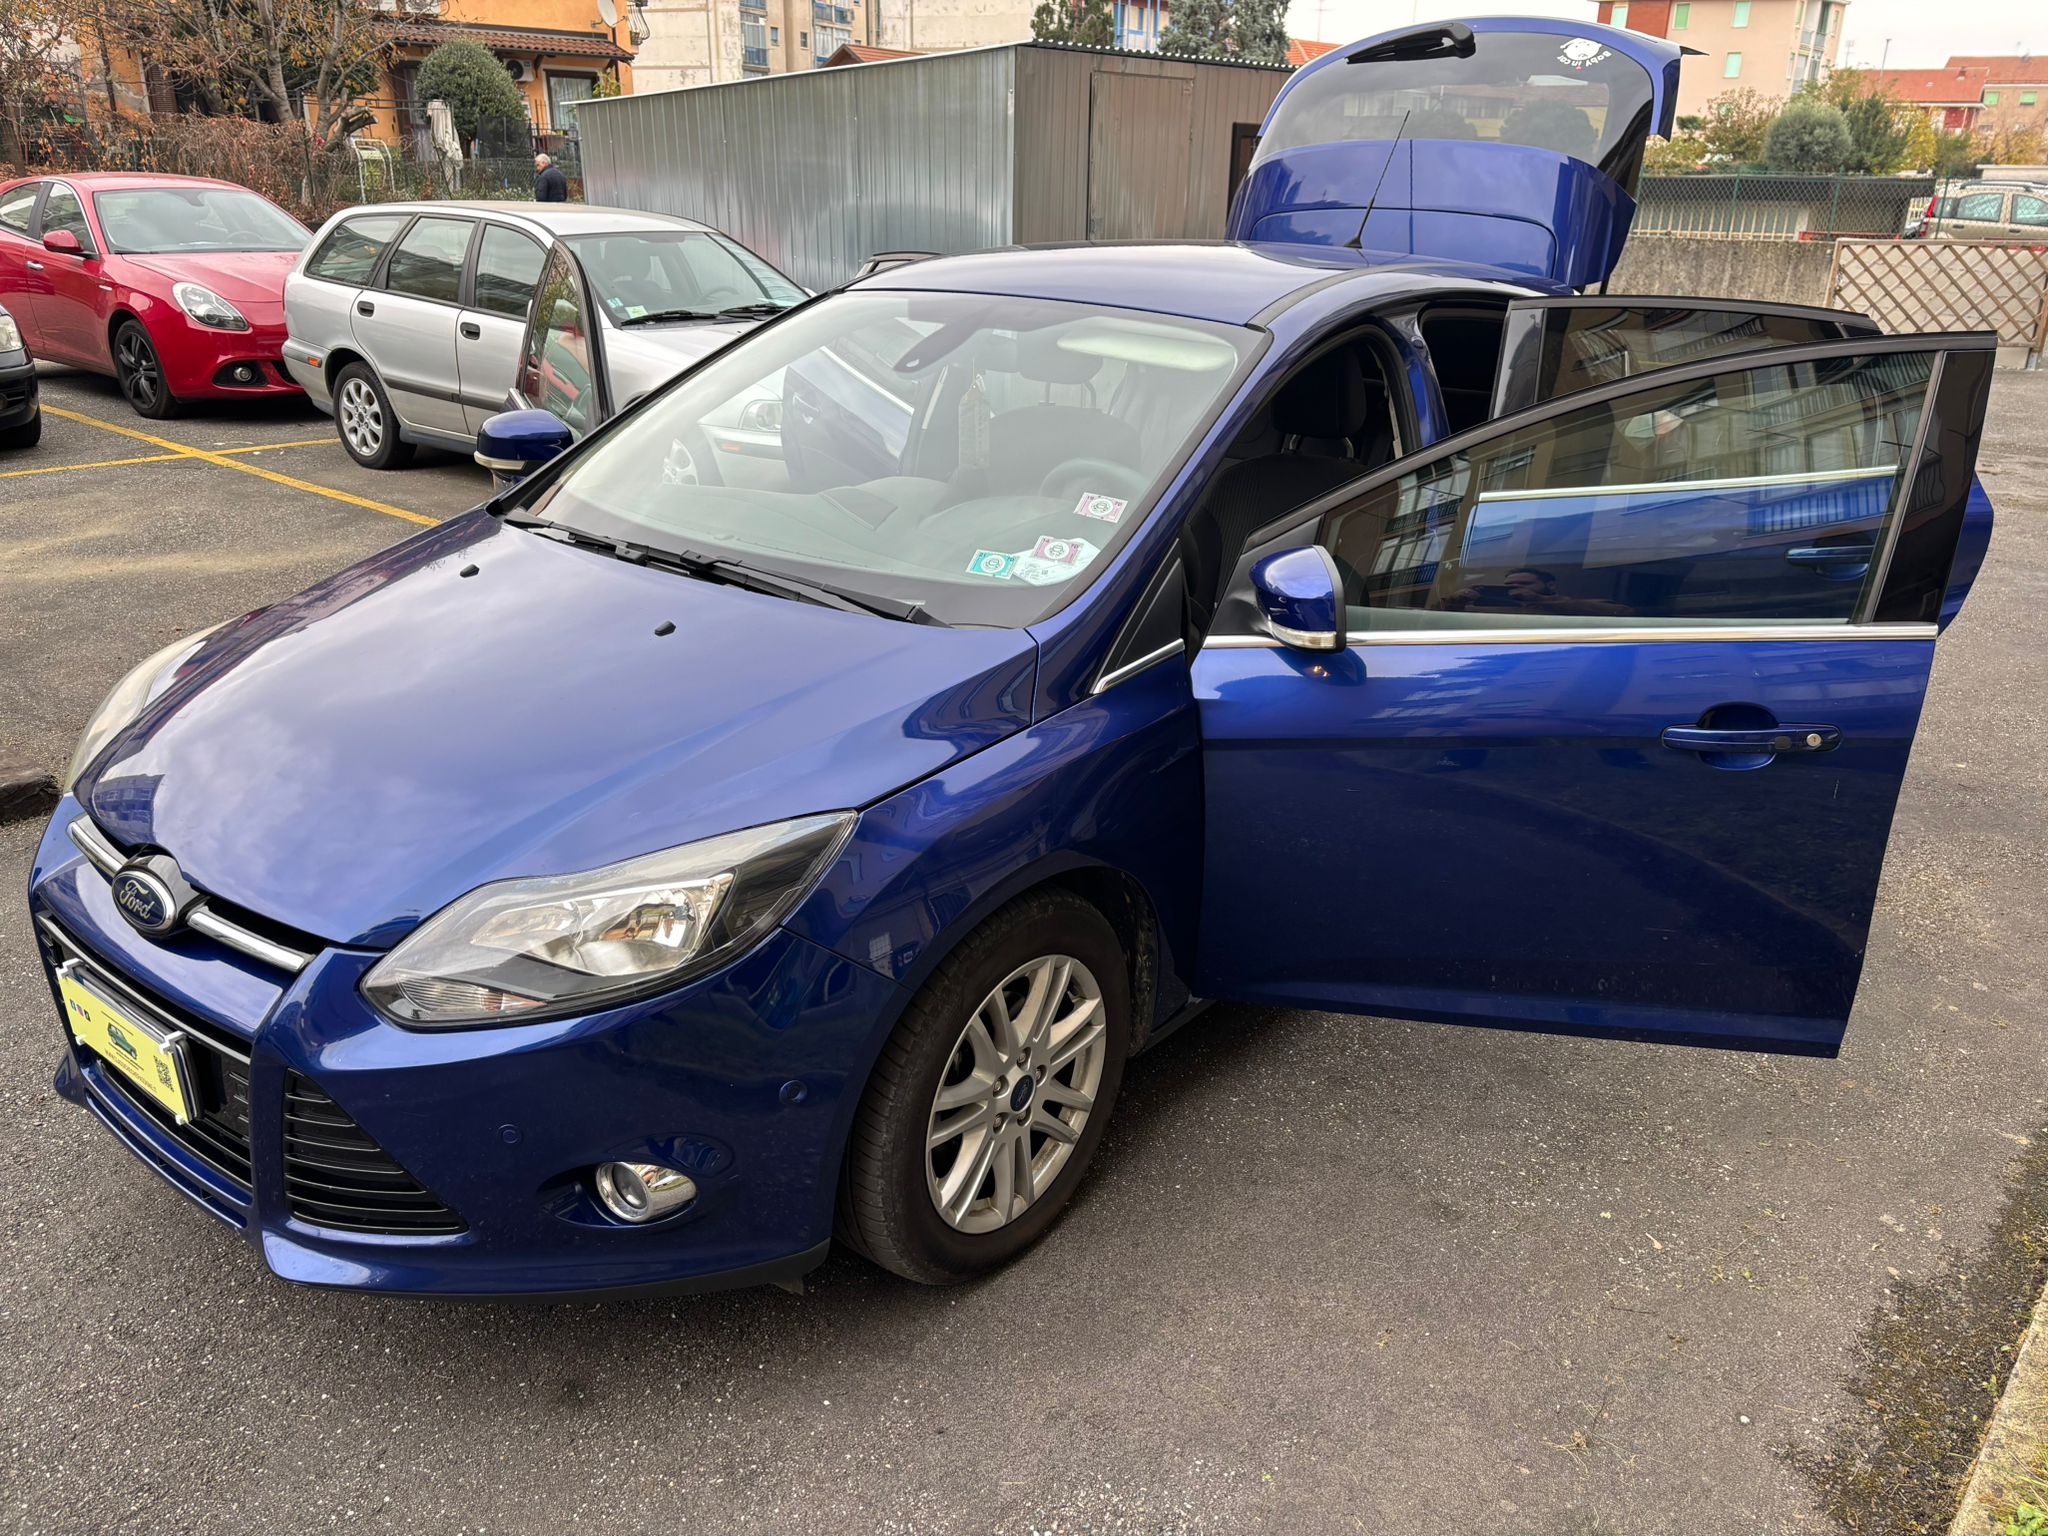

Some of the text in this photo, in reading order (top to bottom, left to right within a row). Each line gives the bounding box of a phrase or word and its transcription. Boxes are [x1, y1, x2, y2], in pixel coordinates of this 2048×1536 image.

[1556, 55, 1571, 65] car
[1585, 50, 1612, 67] Baby
[119, 879, 155, 920] Ford
